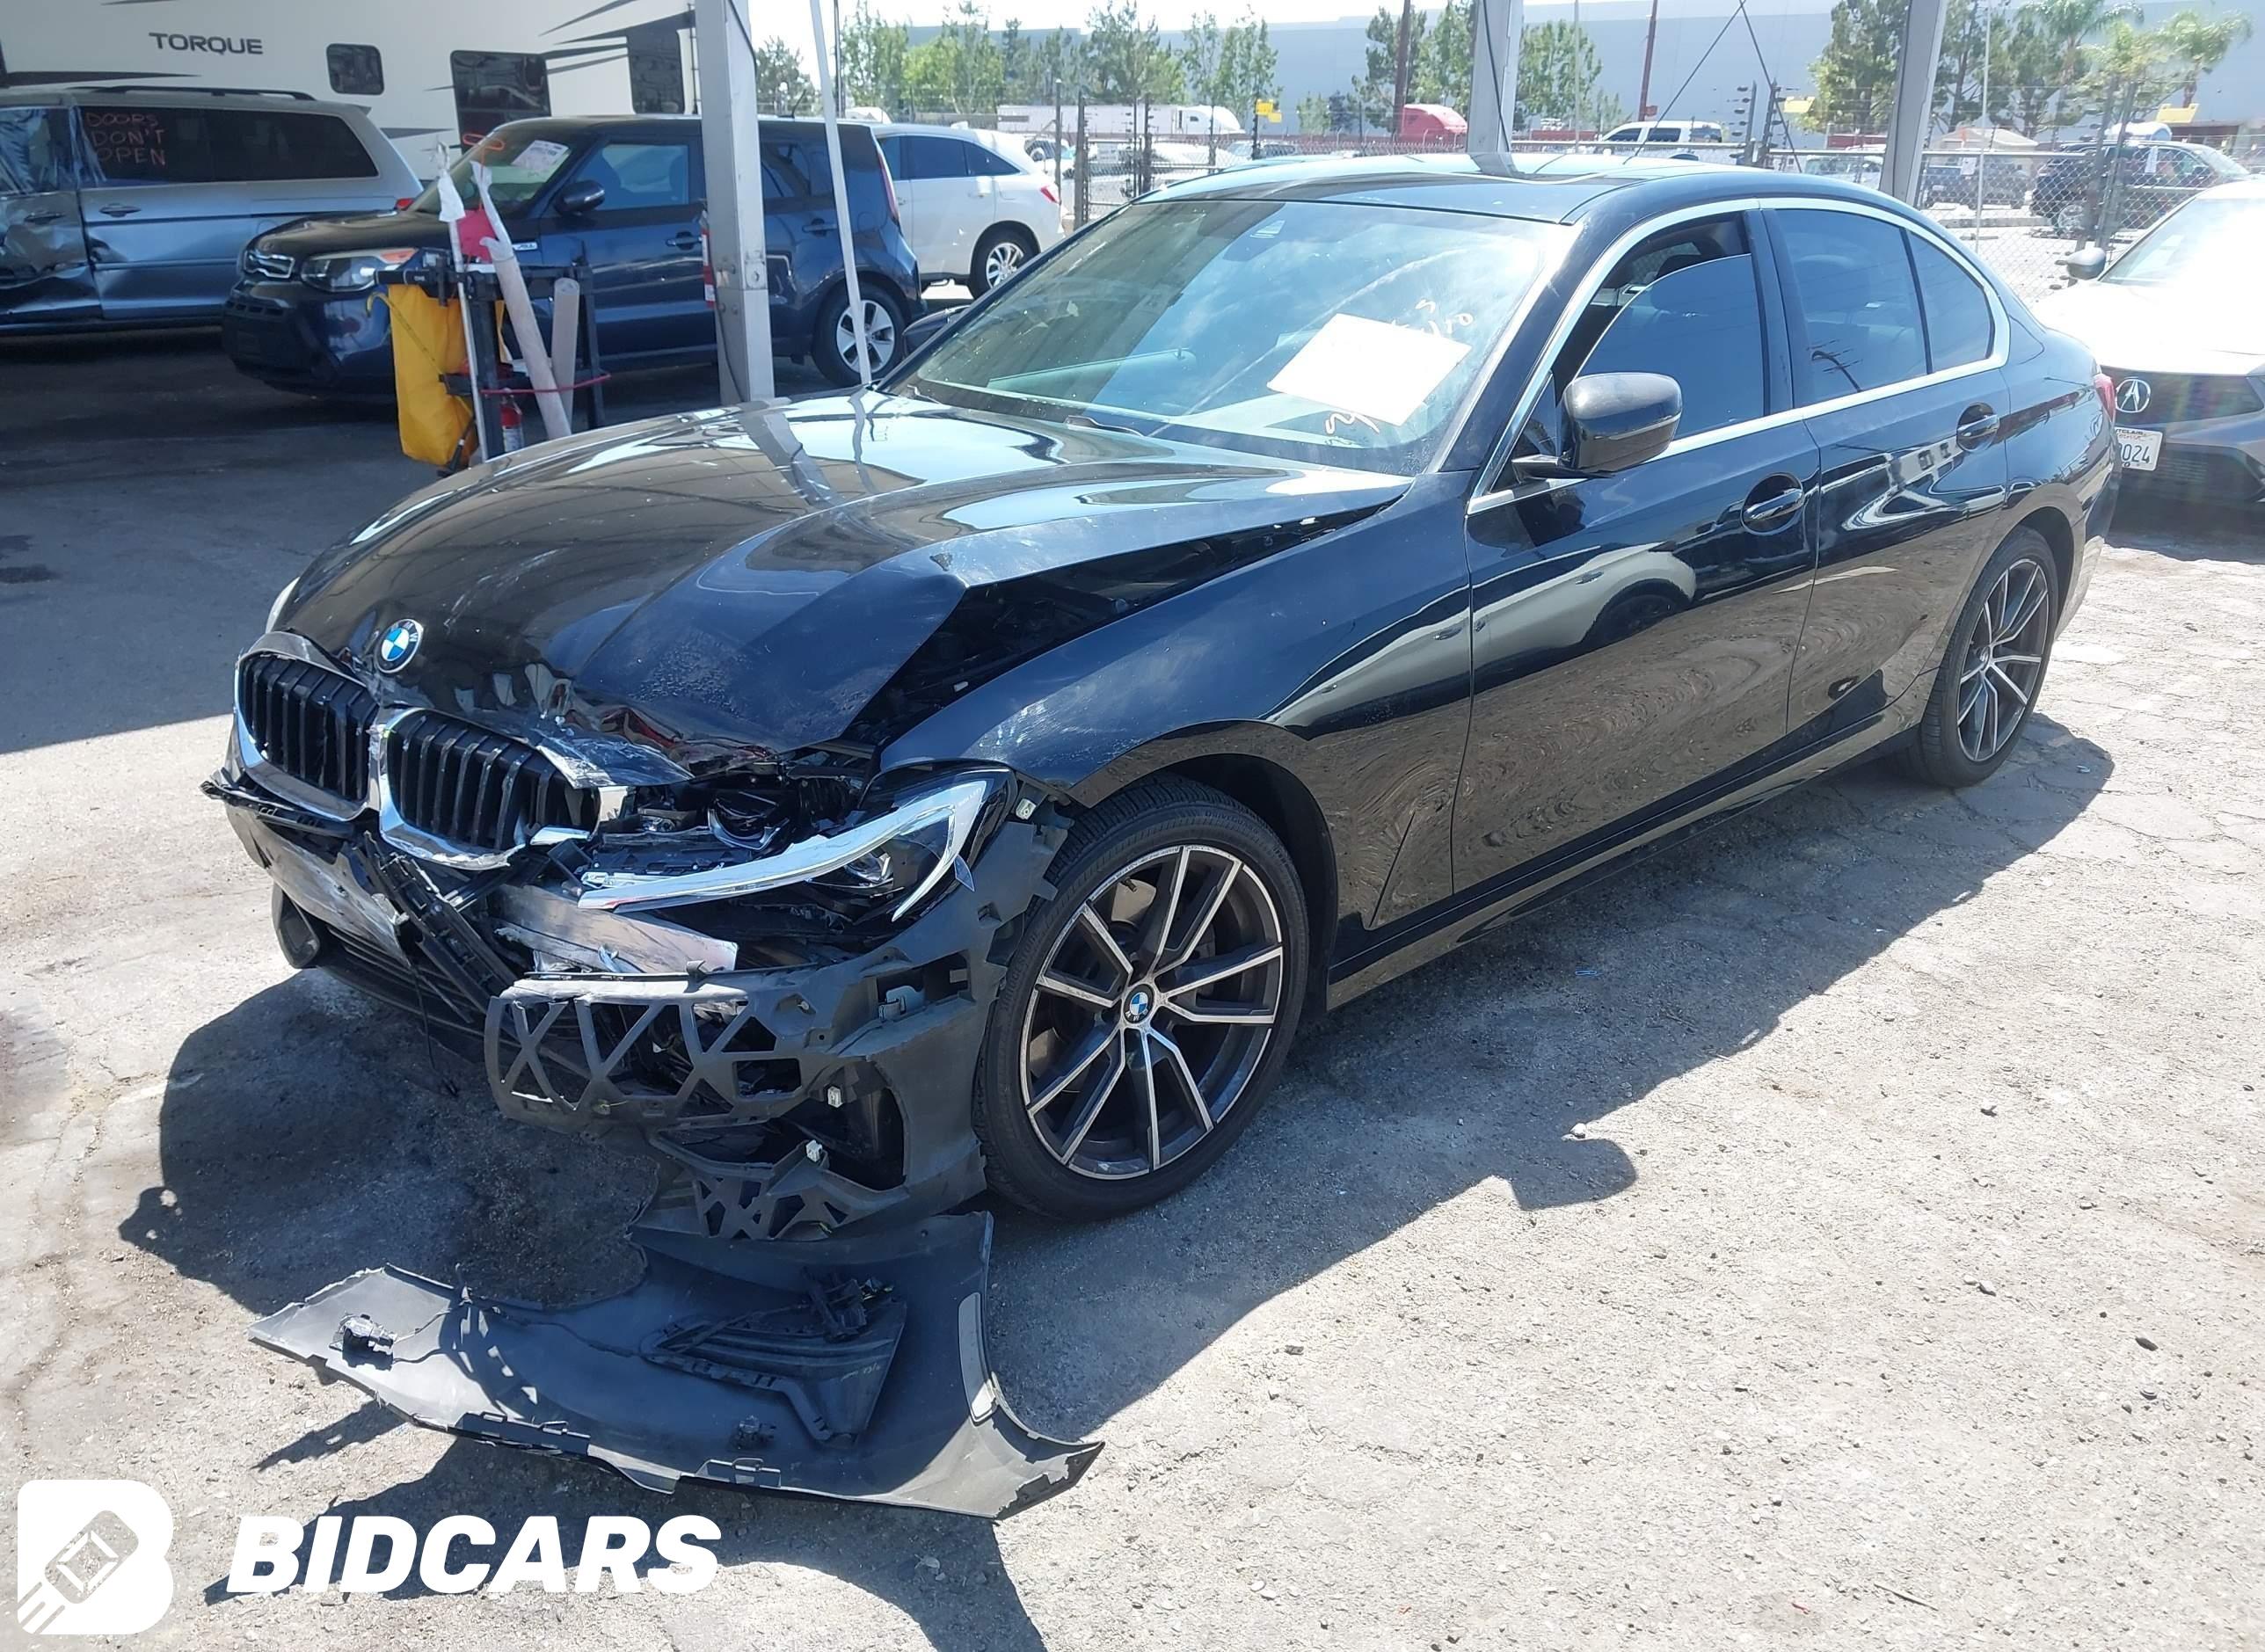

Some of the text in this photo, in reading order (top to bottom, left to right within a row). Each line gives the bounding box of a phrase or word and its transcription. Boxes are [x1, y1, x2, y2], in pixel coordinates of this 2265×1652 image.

[149, 32, 263, 55] TORQUE
[85, 112, 158, 127] DOORS
[91, 129, 164, 147] DON'T
[97, 147, 165, 166] OPEN
[2118, 443, 2150, 463] 024
